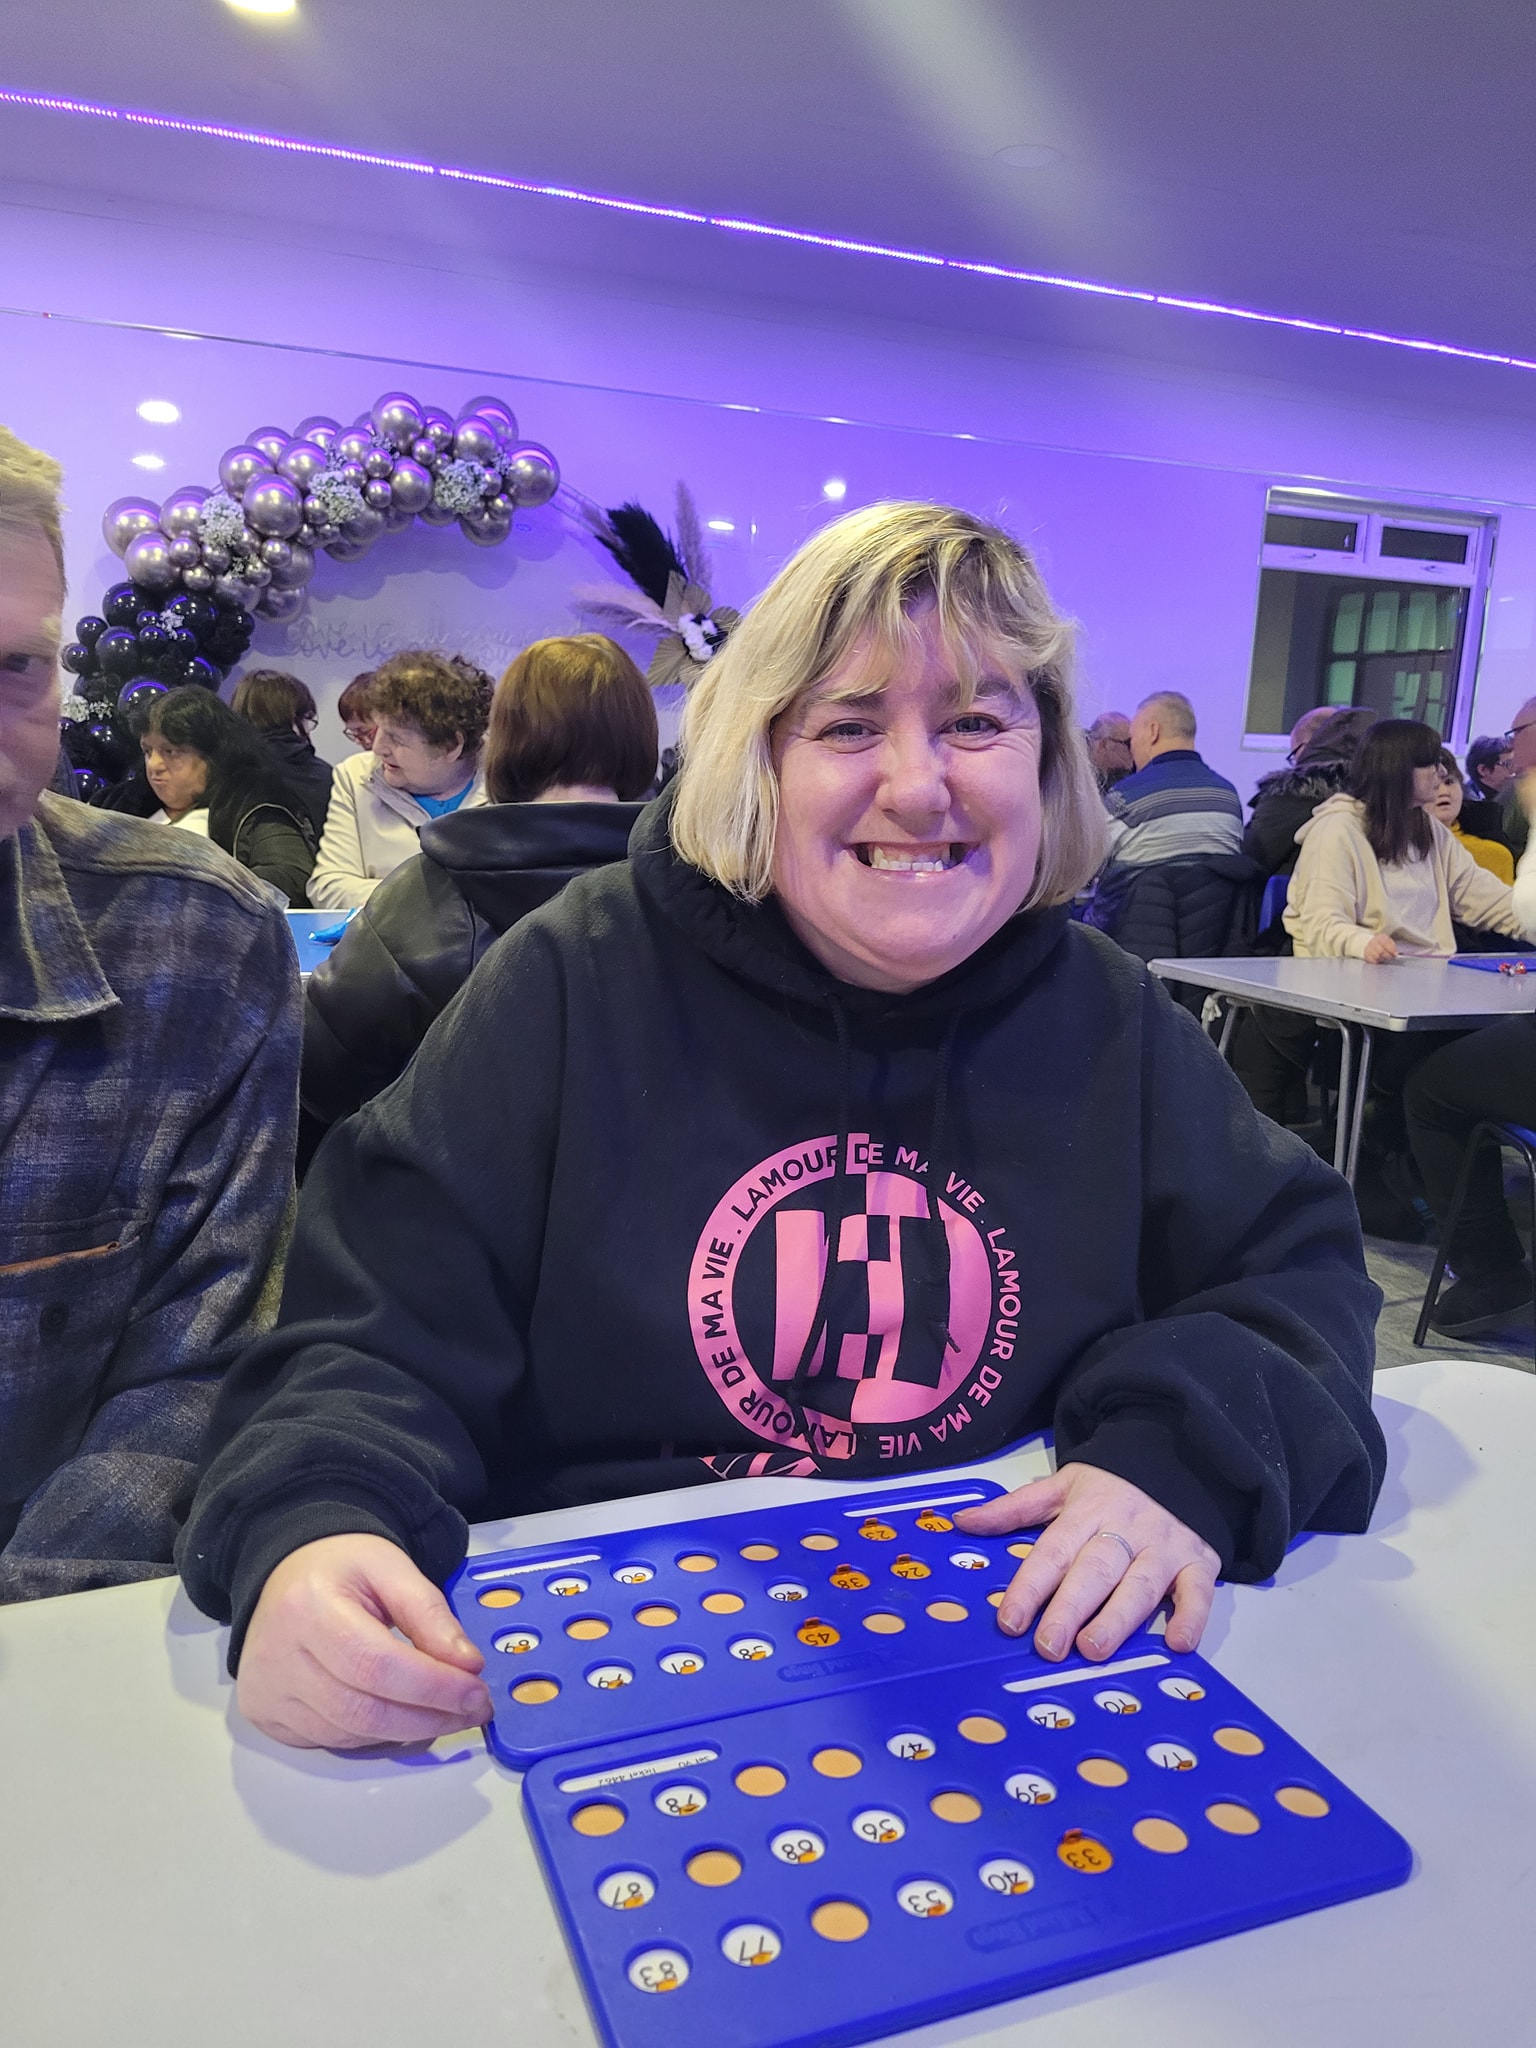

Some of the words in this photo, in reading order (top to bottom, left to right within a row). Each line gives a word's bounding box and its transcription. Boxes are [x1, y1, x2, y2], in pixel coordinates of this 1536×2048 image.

[730, 1146, 837, 1222] LAMOUR
[854, 1143, 884, 1164] DE
[946, 1171, 985, 1213] VIE
[702, 1236, 735, 1280] VIE
[701, 1289, 727, 1338] MA
[987, 1227, 1022, 1361] LAMOUR
[711, 1347, 745, 1388] DE
[967, 1364, 1003, 1407] DE
[928, 1403, 973, 1443] MA
[879, 1432, 922, 1458] VIE
[836, 1577, 863, 1590] 38
[897, 1567, 924, 1580] 24
[805, 1632, 830, 1647] 45
[1066, 1848, 1102, 1870] 33
[638, 1961, 677, 1988] 83
